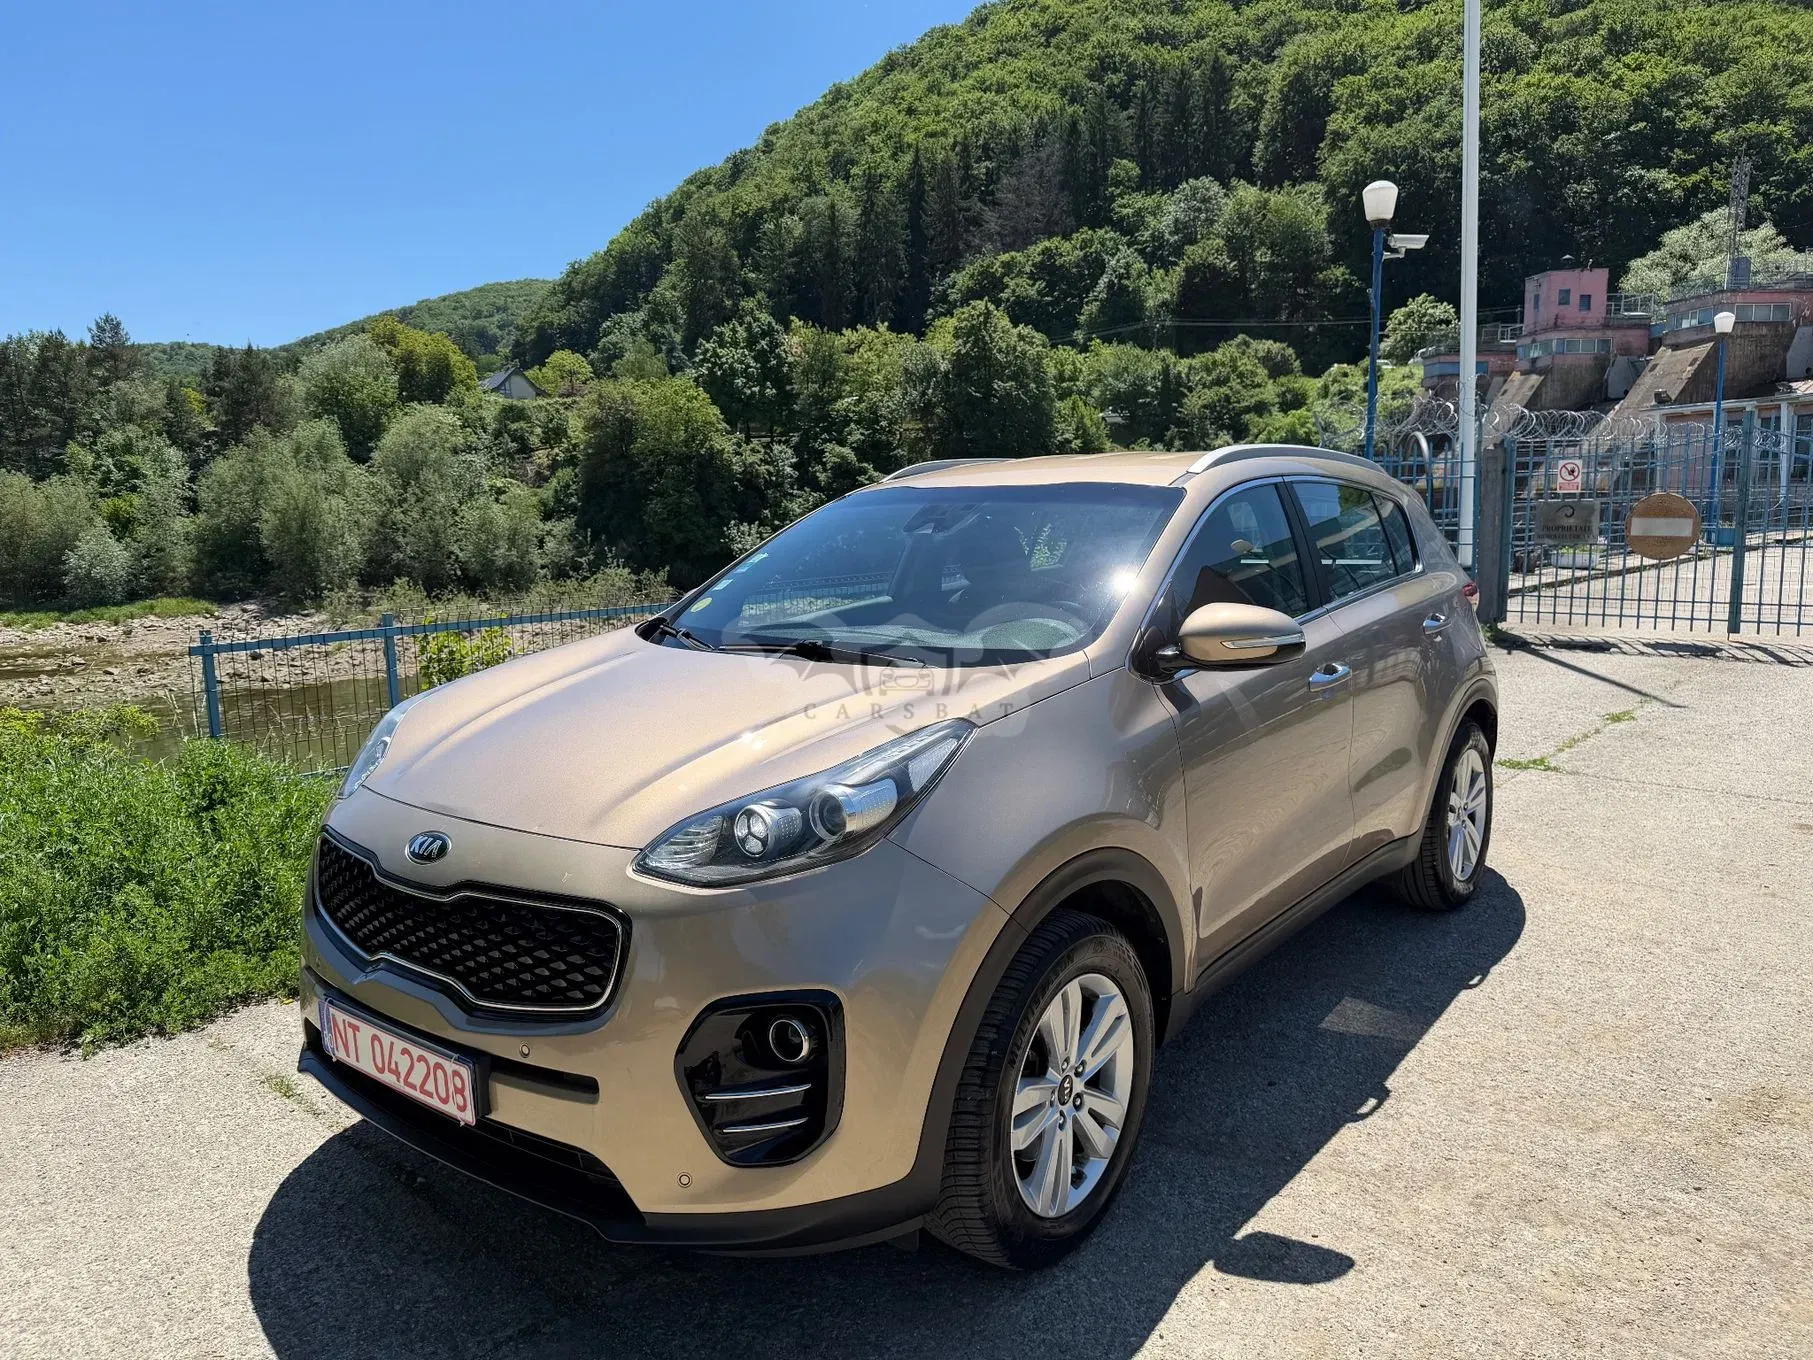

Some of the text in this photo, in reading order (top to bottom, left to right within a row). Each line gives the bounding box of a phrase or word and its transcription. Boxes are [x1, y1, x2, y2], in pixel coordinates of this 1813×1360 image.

[410, 835, 443, 858] KIA
[331, 1014, 468, 1113] NT 042208
